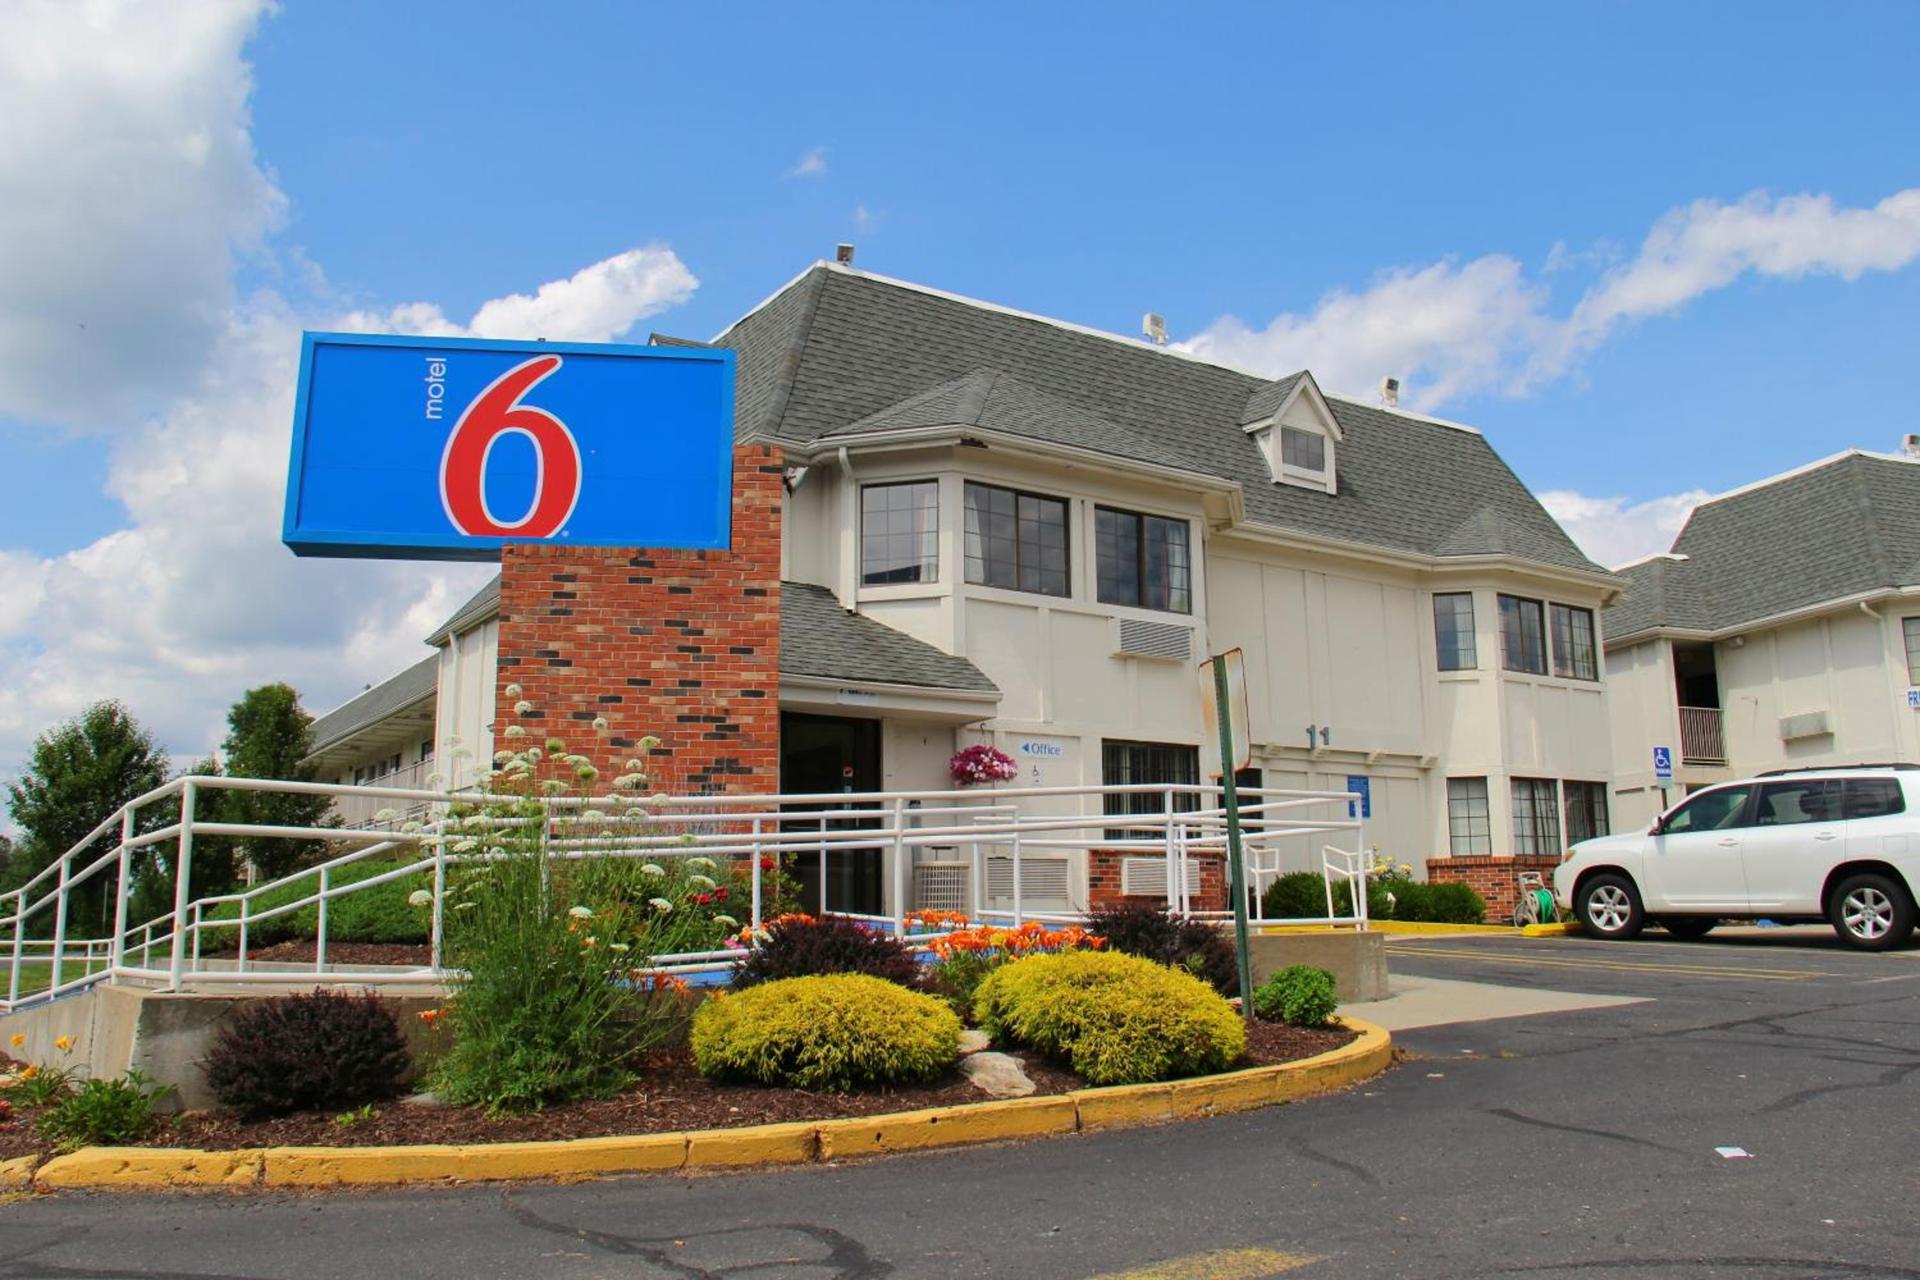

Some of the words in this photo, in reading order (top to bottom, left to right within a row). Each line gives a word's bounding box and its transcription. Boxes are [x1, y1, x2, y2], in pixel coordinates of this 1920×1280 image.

[424, 357, 447, 419] motel
[439, 353, 583, 538] 6
[1907, 690, 1920, 705] FR
[1031, 742, 1061, 756] Office
